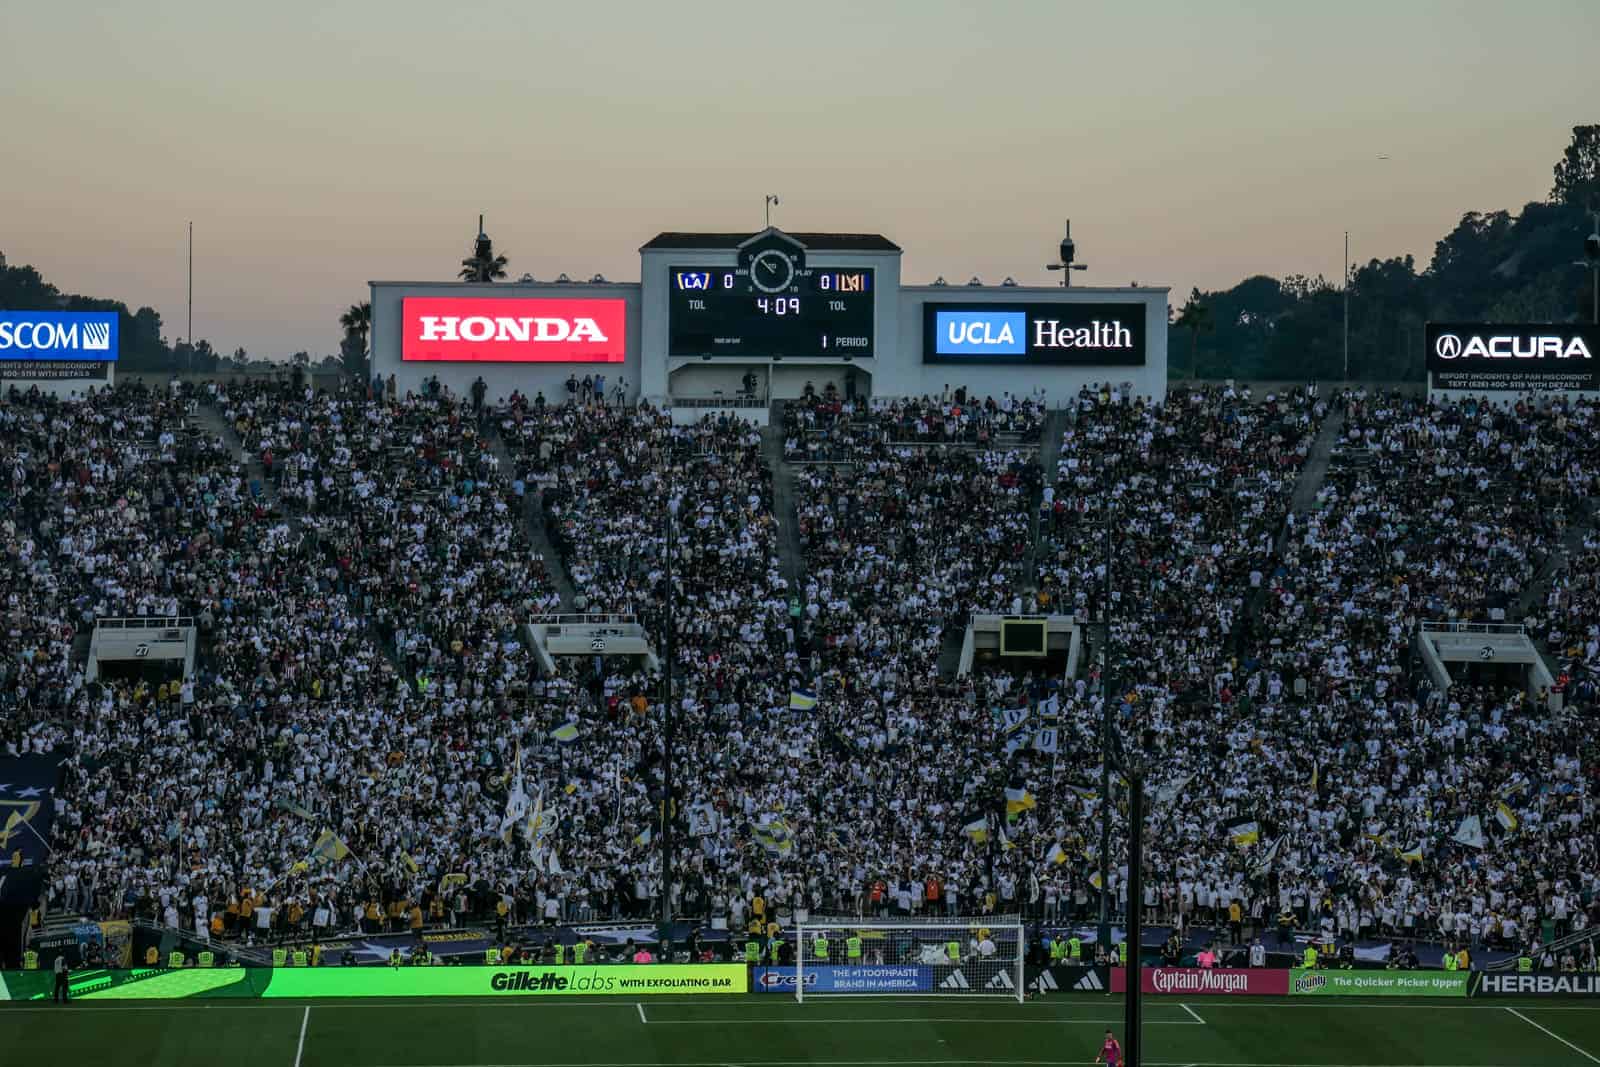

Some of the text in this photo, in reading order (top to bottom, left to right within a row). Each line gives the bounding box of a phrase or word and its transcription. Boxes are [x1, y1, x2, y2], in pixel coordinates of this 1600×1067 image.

[723, 274, 734, 289] 0
[820, 275, 831, 290] 0
[688, 300, 706, 310] TOL
[757, 298, 800, 315] 4:09
[829, 301, 847, 311] TOL
[419, 315, 609, 342] HONDA
[949, 320, 1133, 348] UCLA Health
[0, 322, 79, 350] SCOM
[835, 337, 869, 347] PERIOD
[1462, 336, 1592, 359] ACURA
[136, 647, 150, 656] 27
[832, 969, 849, 977] THE
[863, 968, 919, 977] TOOTHPASTE
[619, 978, 645, 988] WITH
[647, 978, 709, 988] EXFOLIATING
[712, 978, 732, 987] BAR
[834, 978, 918, 988] BRAND IN AMERICA
[1152, 968, 1248, 993] Captain Morgan
[1333, 978, 1463, 990] The Quicker Picker Upper
